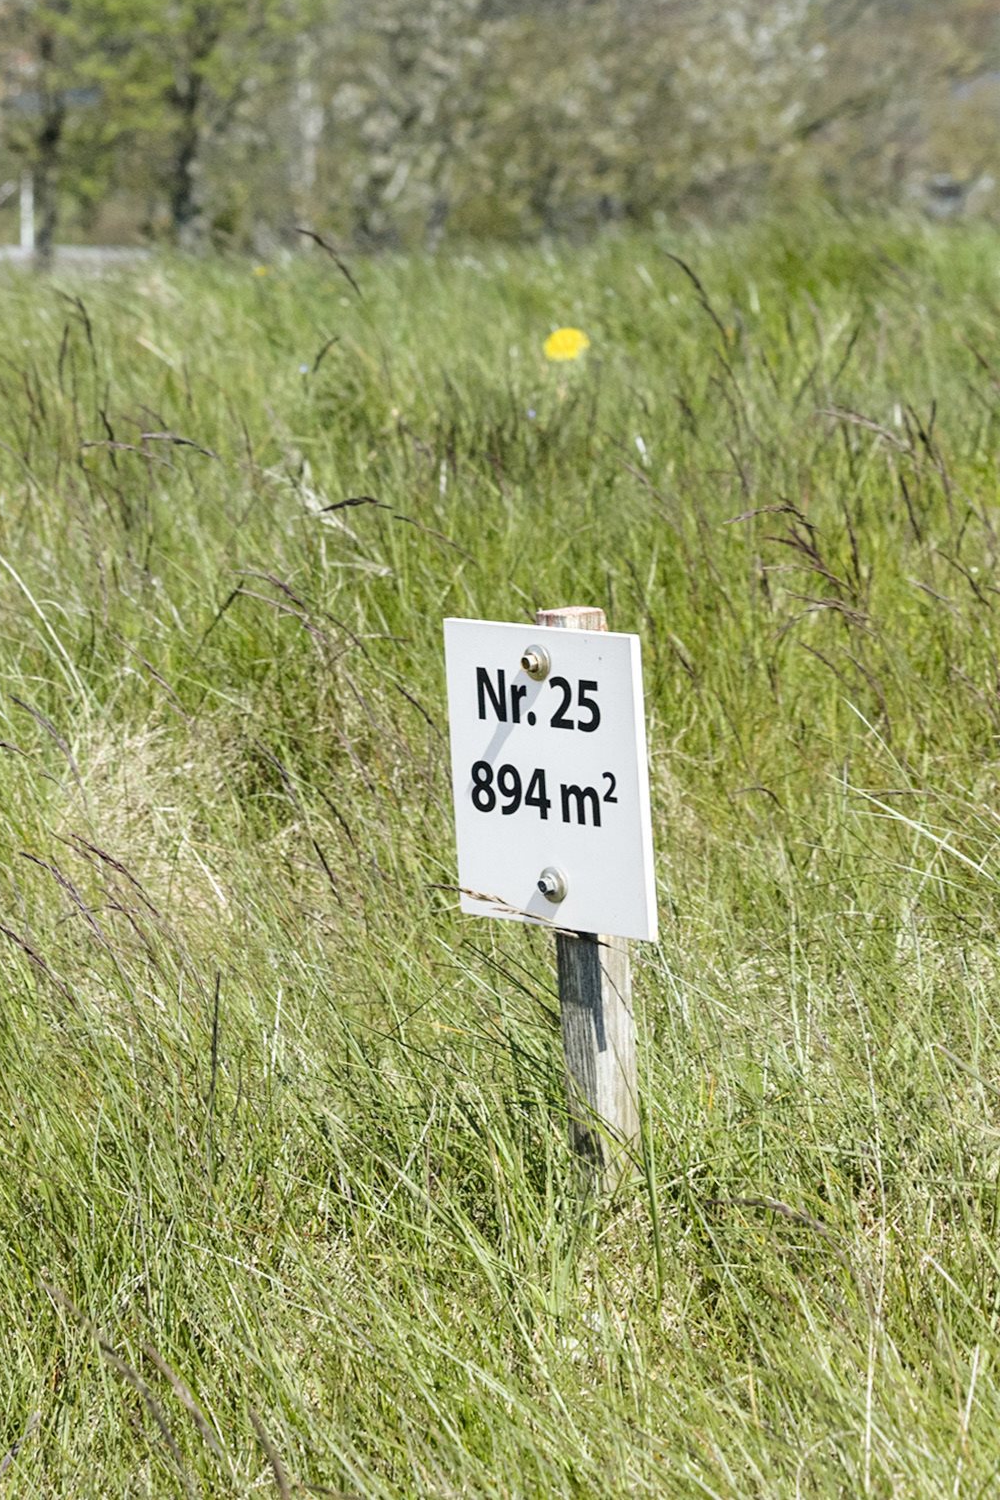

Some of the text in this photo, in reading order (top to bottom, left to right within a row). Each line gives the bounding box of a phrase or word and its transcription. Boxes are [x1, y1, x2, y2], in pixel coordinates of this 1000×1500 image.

[476, 667, 601, 733] Nr. 25
[471, 760, 618, 827] 894 m²
